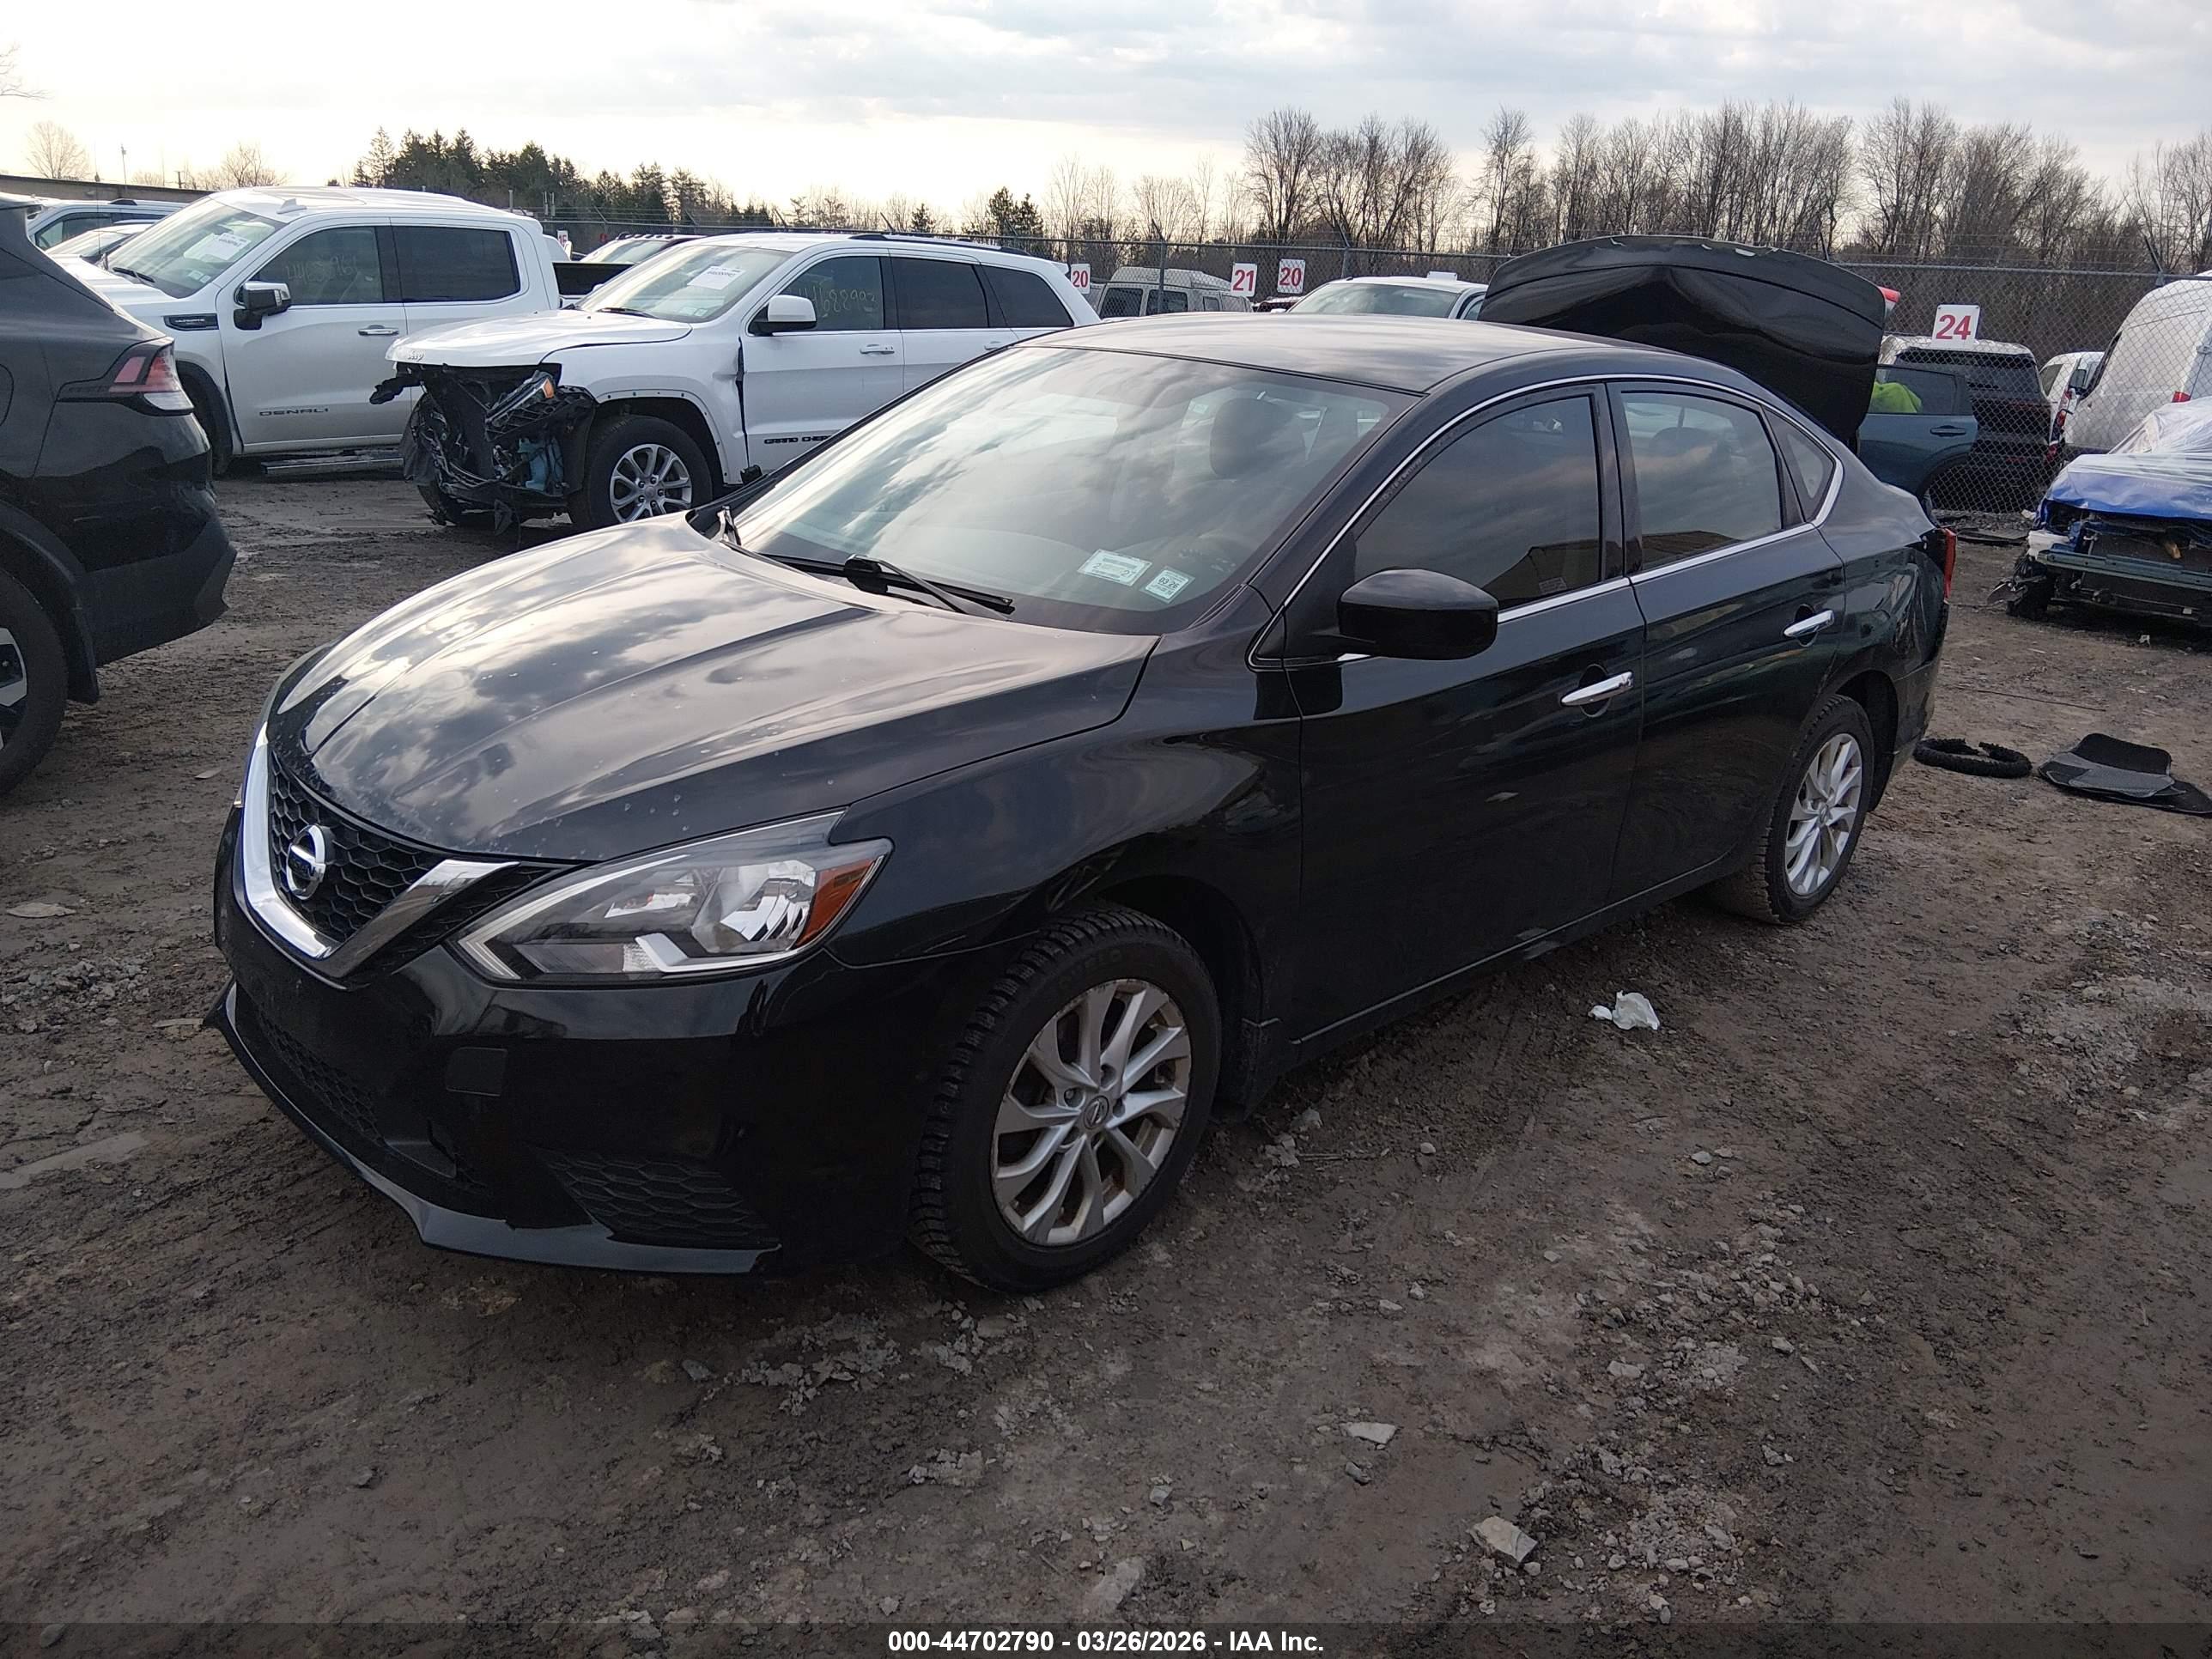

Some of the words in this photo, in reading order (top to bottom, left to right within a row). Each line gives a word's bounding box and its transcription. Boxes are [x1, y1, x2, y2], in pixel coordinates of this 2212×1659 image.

[1073, 270, 1089, 288] 20
[1232, 269, 1255, 292] 21
[1279, 266, 1303, 288] 20
[1936, 314, 1972, 341] 24
[259, 408, 329, 416] DENALI
